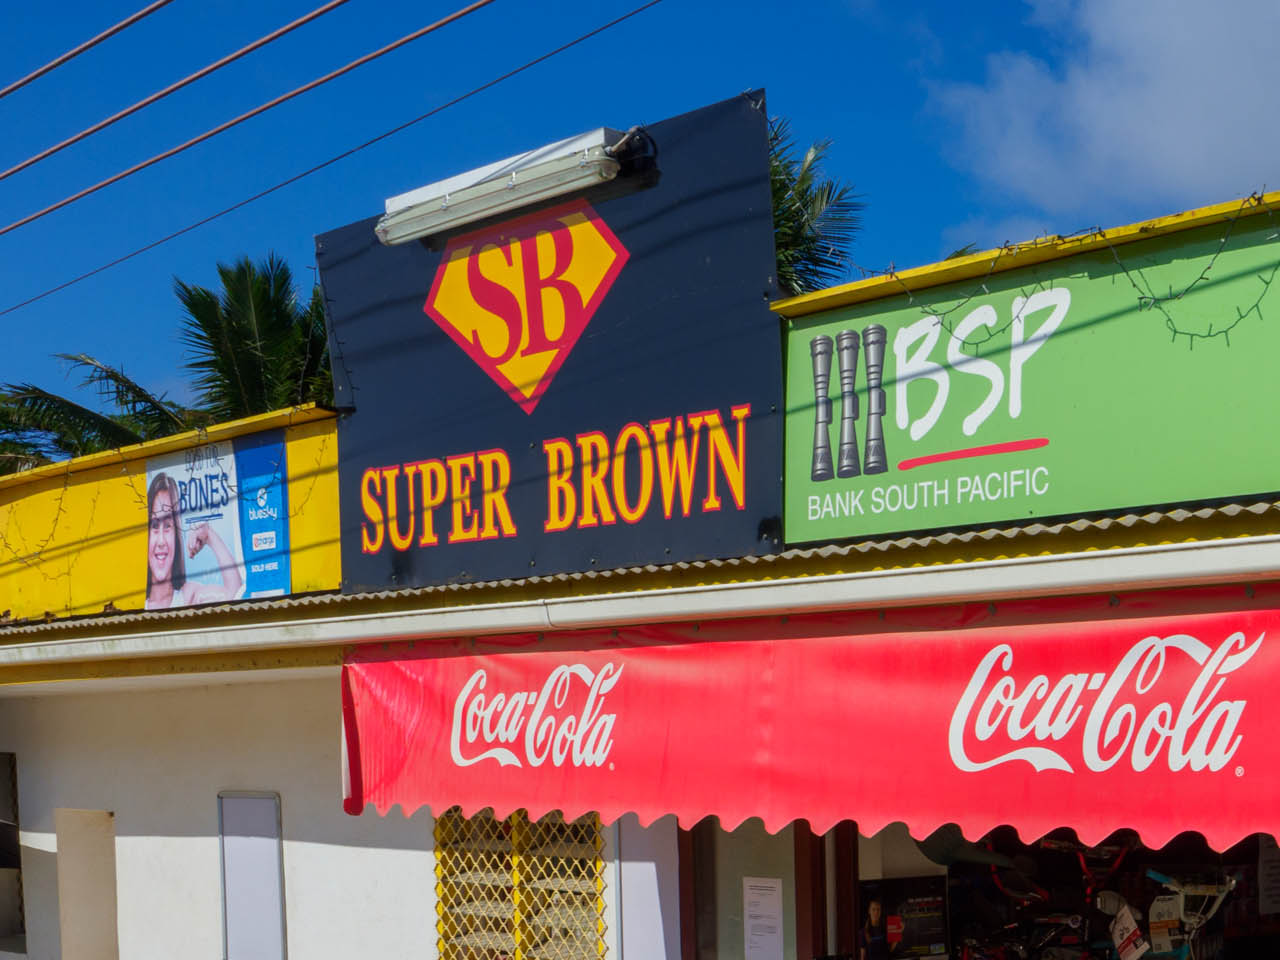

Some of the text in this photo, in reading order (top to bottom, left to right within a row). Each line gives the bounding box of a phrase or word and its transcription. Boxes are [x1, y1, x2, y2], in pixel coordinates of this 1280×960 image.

[467, 217, 586, 367] SB
[893, 287, 1071, 441] BSP
[178, 472, 229, 514] BONES
[361, 403, 751, 555] SUPER BROWN
[807, 466, 1050, 520] BANK SOUTH PACIFIC
[450, 661, 624, 770] Coca-Cola
[948, 630, 1266, 774] Coca-Cola
